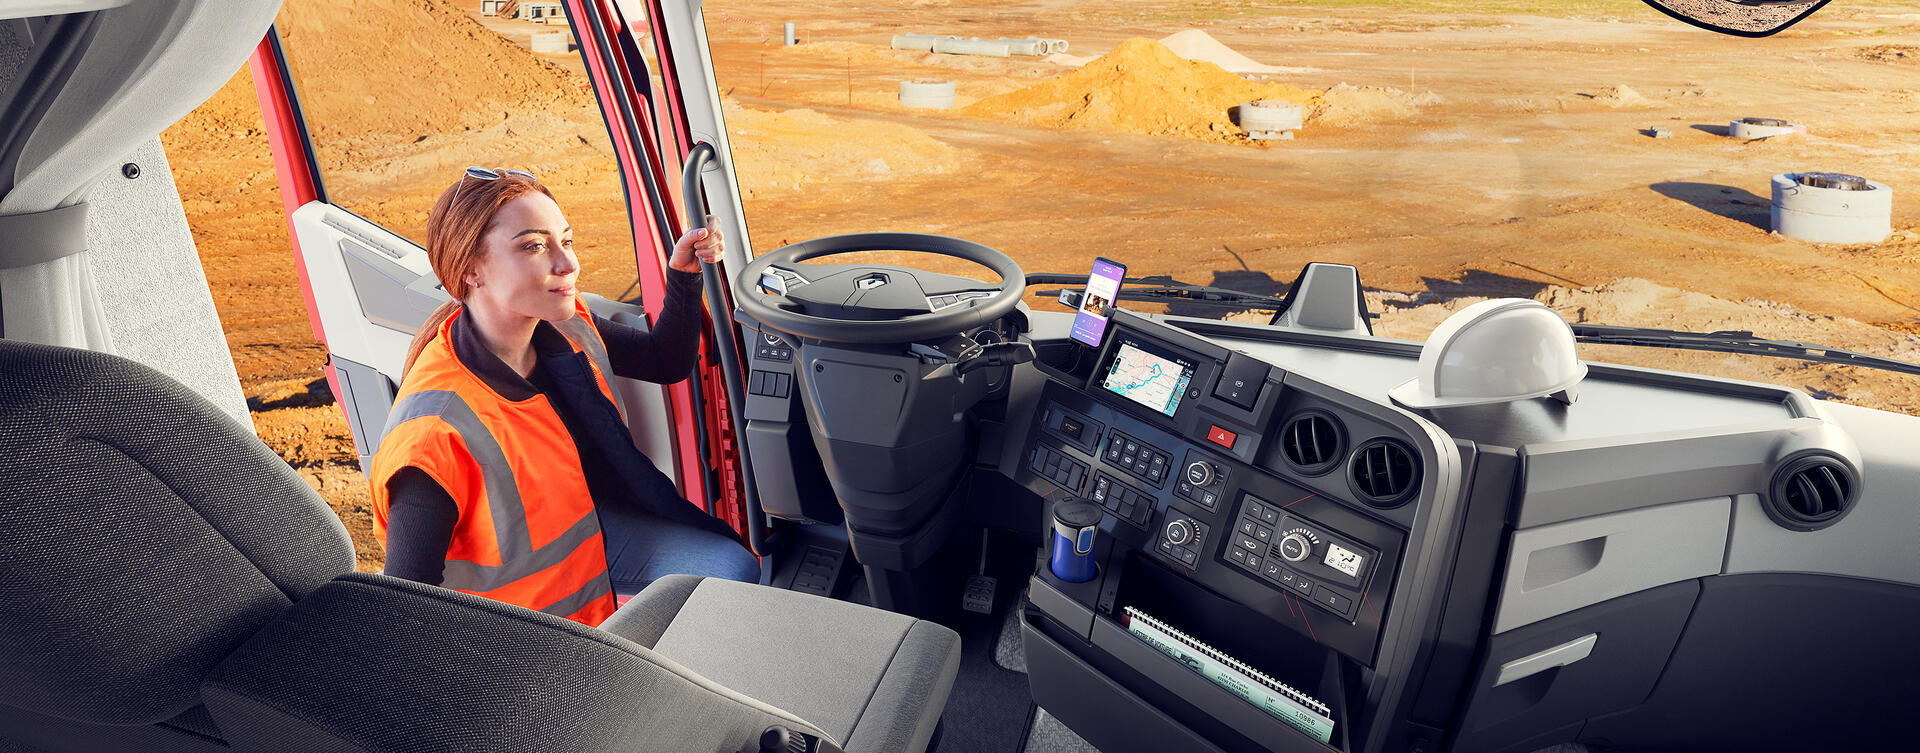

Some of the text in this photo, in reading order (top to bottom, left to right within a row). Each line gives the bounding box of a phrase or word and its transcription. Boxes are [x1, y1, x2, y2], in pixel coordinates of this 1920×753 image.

[1286, 545, 1299, 553] AUTO
[1133, 628, 1149, 640] LETTRE
[1154, 639, 1173, 655] VOITURE
[1295, 710, 1316, 725] 10986
